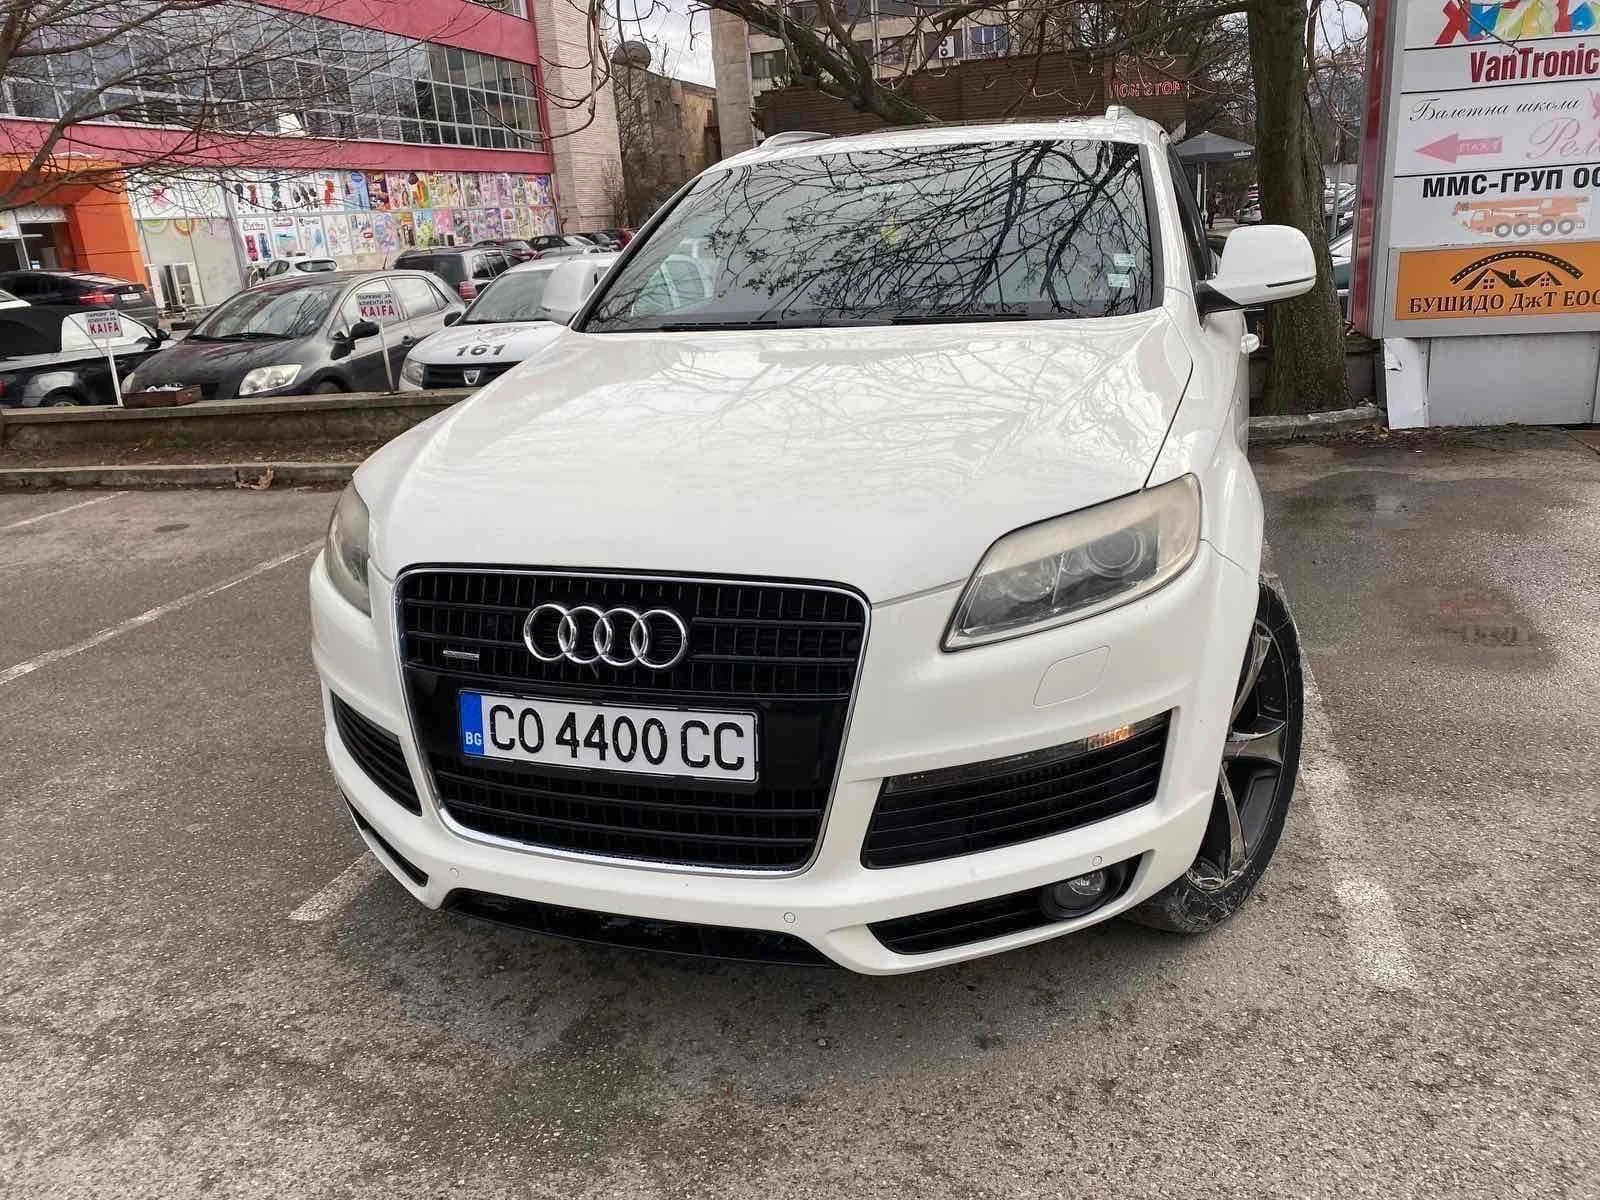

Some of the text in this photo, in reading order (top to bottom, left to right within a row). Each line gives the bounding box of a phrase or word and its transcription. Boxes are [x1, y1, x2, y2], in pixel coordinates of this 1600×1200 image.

[1470, 43, 1600, 83] VanTronic
[1143, 81, 1181, 96] STOP
[1409, 98, 1580, 122] Балетна школа
[1422, 168, 1563, 198] ММС-ГРУП
[360, 304, 395, 317] KAIFA
[1410, 294, 1504, 314] БУШИДО
[1509, 291, 1557, 312] ДжТ
[89, 321, 120, 335] KAIFA
[456, 344, 506, 357] 161
[464, 731, 483, 747] BG
[488, 704, 745, 771] CO 4400 CC
